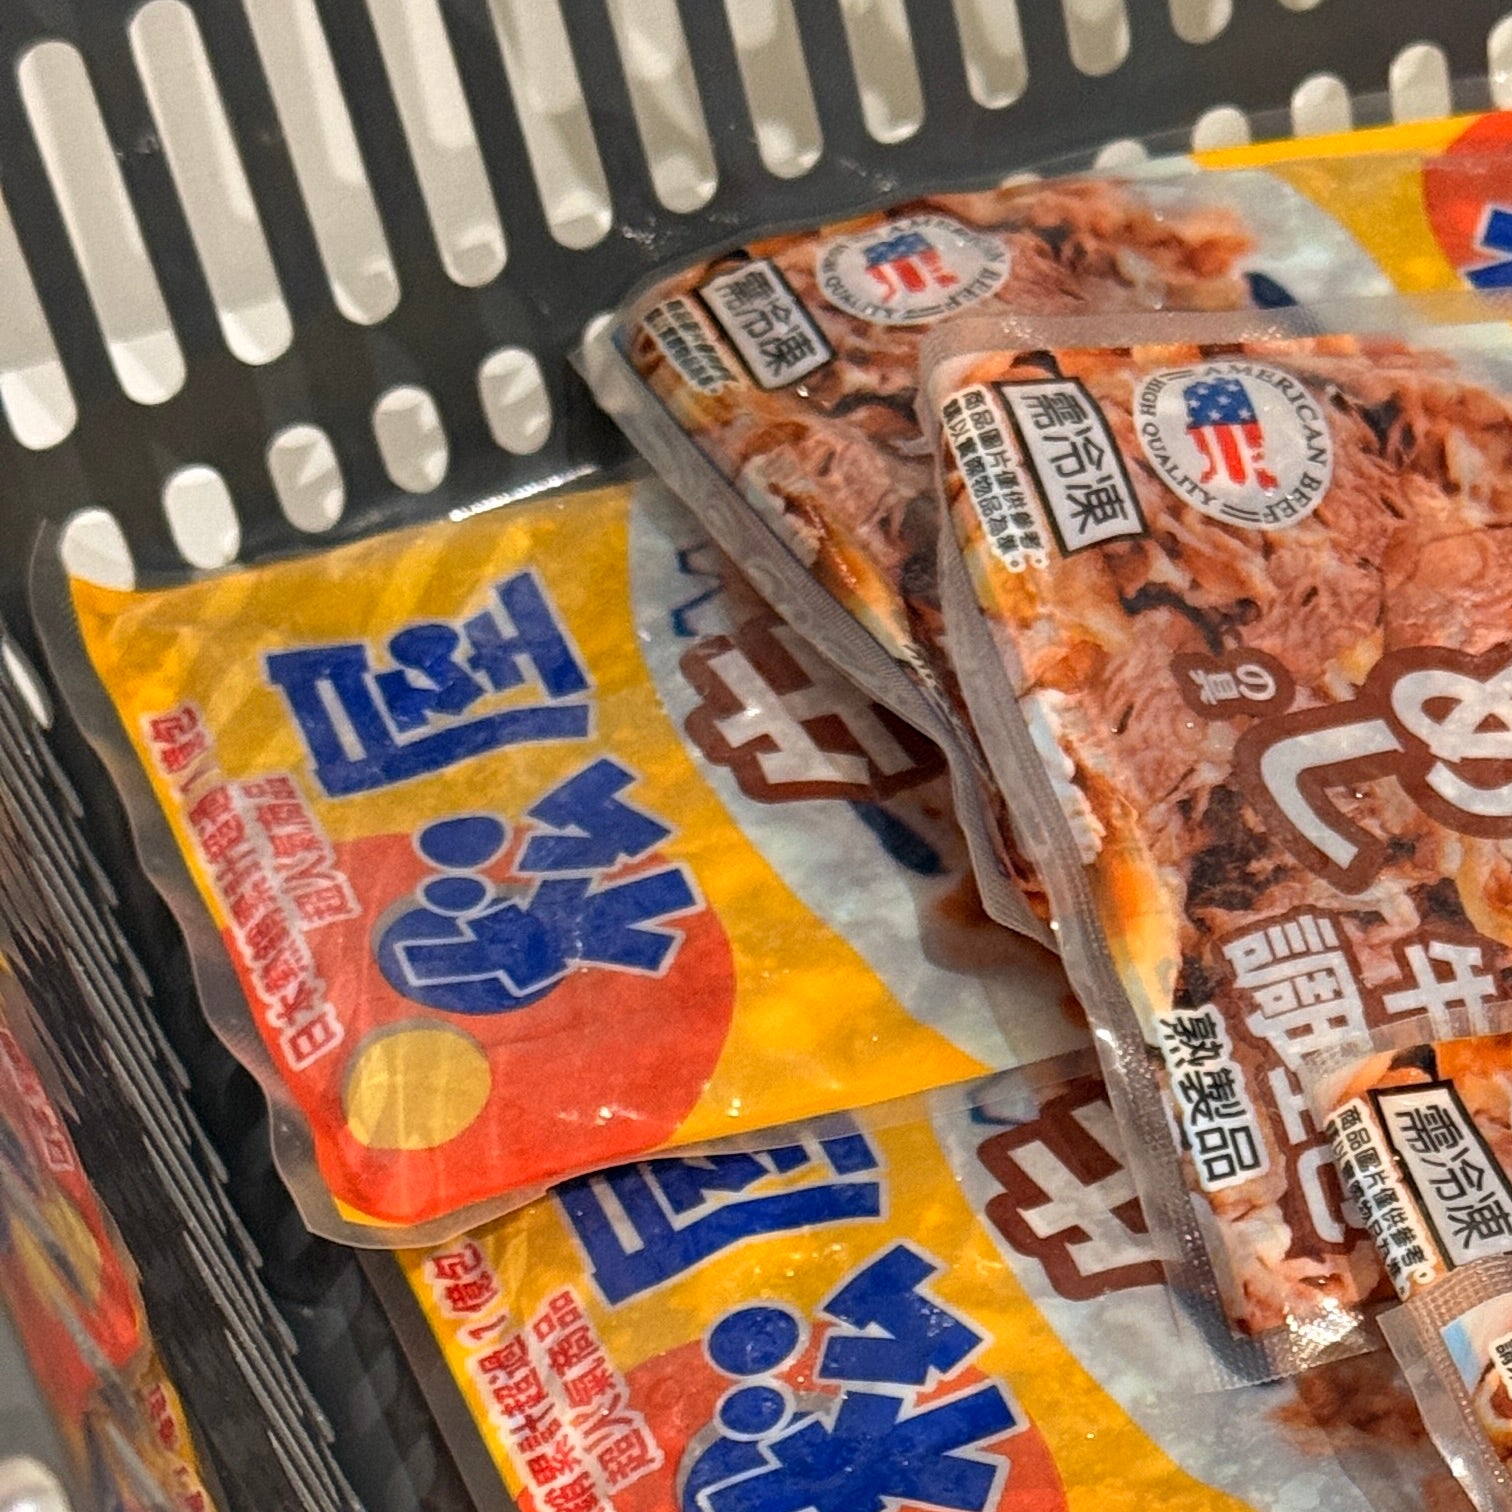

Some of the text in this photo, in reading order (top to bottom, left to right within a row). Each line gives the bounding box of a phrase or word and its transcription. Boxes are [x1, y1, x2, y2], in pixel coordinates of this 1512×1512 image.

[1020, 391, 1128, 536] 需冷凍
[1147, 422, 1214, 508] QUALITY
[1201, 364, 1327, 524] AMERICAN BEEF
[1162, 1012, 1262, 1182] 熟製品
[530, 1290, 662, 1492] 超人氣商品
